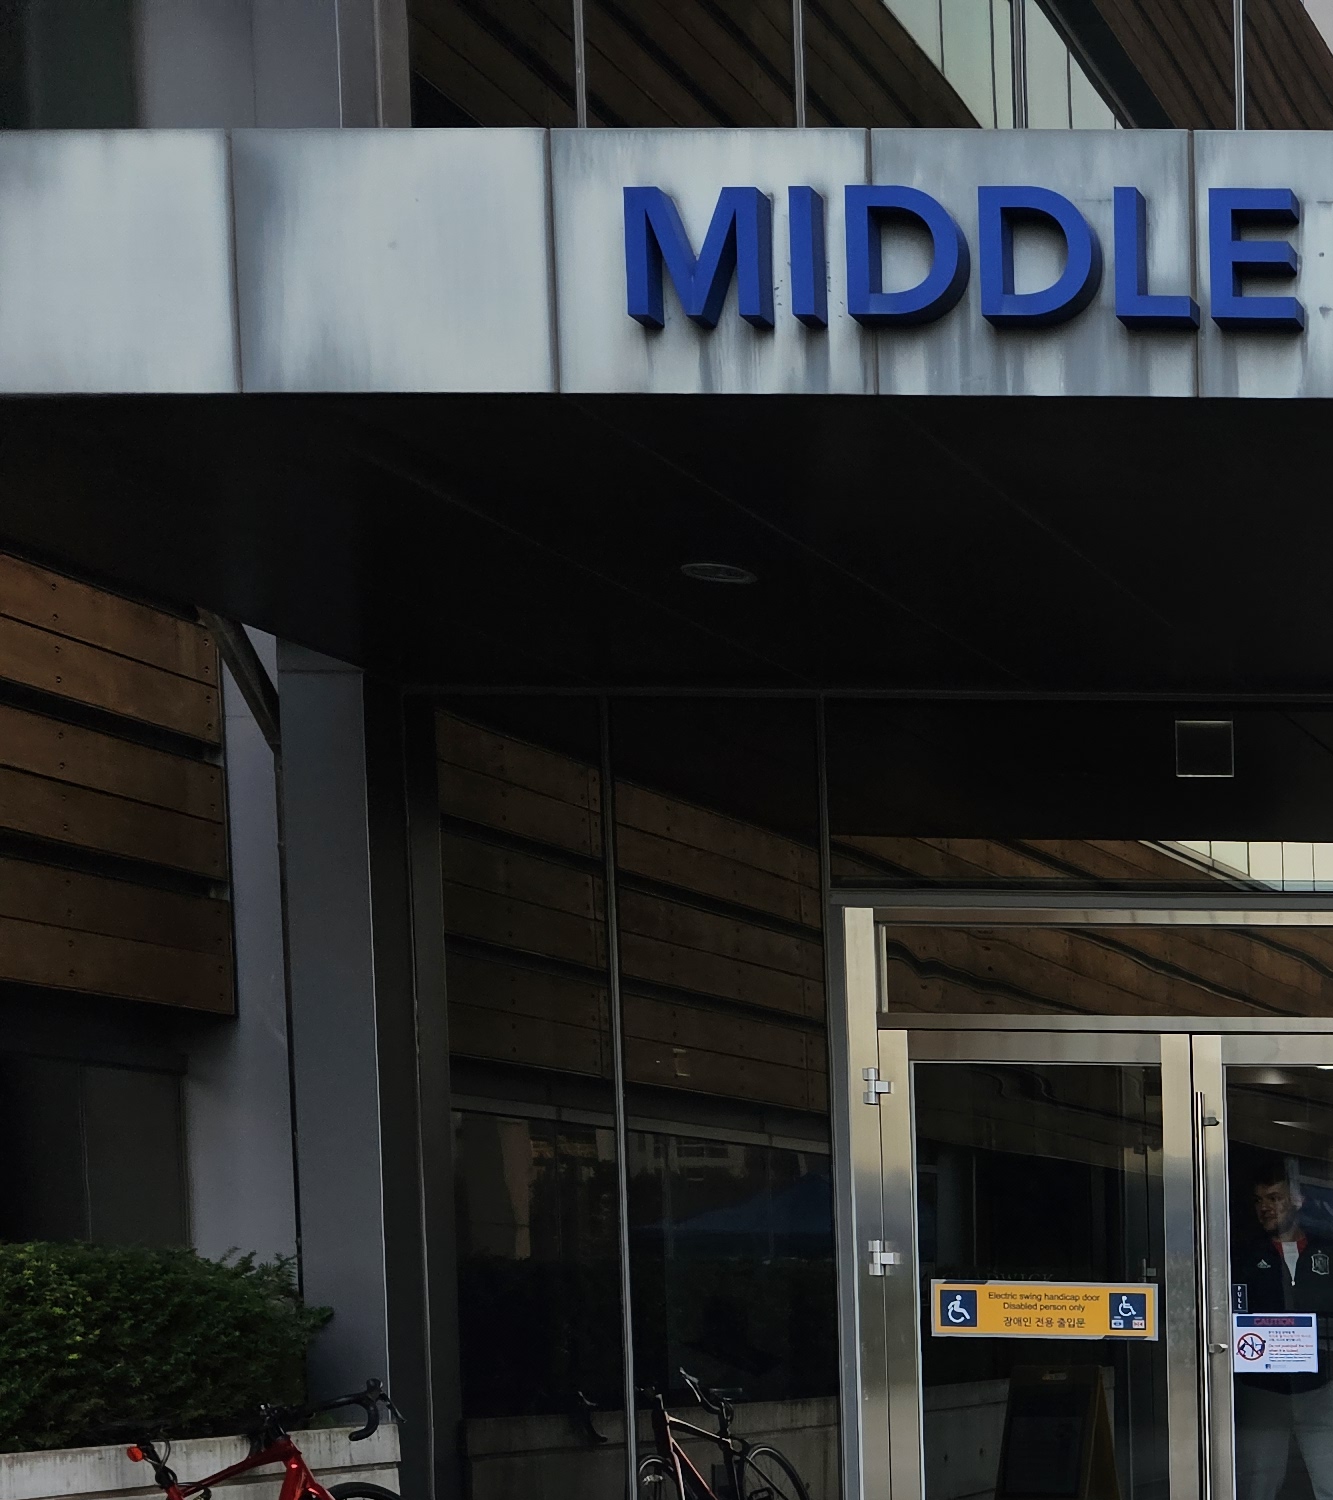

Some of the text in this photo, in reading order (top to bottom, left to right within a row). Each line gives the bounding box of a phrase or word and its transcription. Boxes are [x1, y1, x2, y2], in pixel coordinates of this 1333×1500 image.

[623, 186, 1305, 331] MIDDLE
[988, 1292, 1017, 1300] Electric
[1019, 1292, 1042, 1302] swing
[1044, 1293, 1080, 1302] handicap
[1003, 1302, 1085, 1312] Disabled person only
[1003, 1317, 1085, 1328] 장애인 전용 출입문
